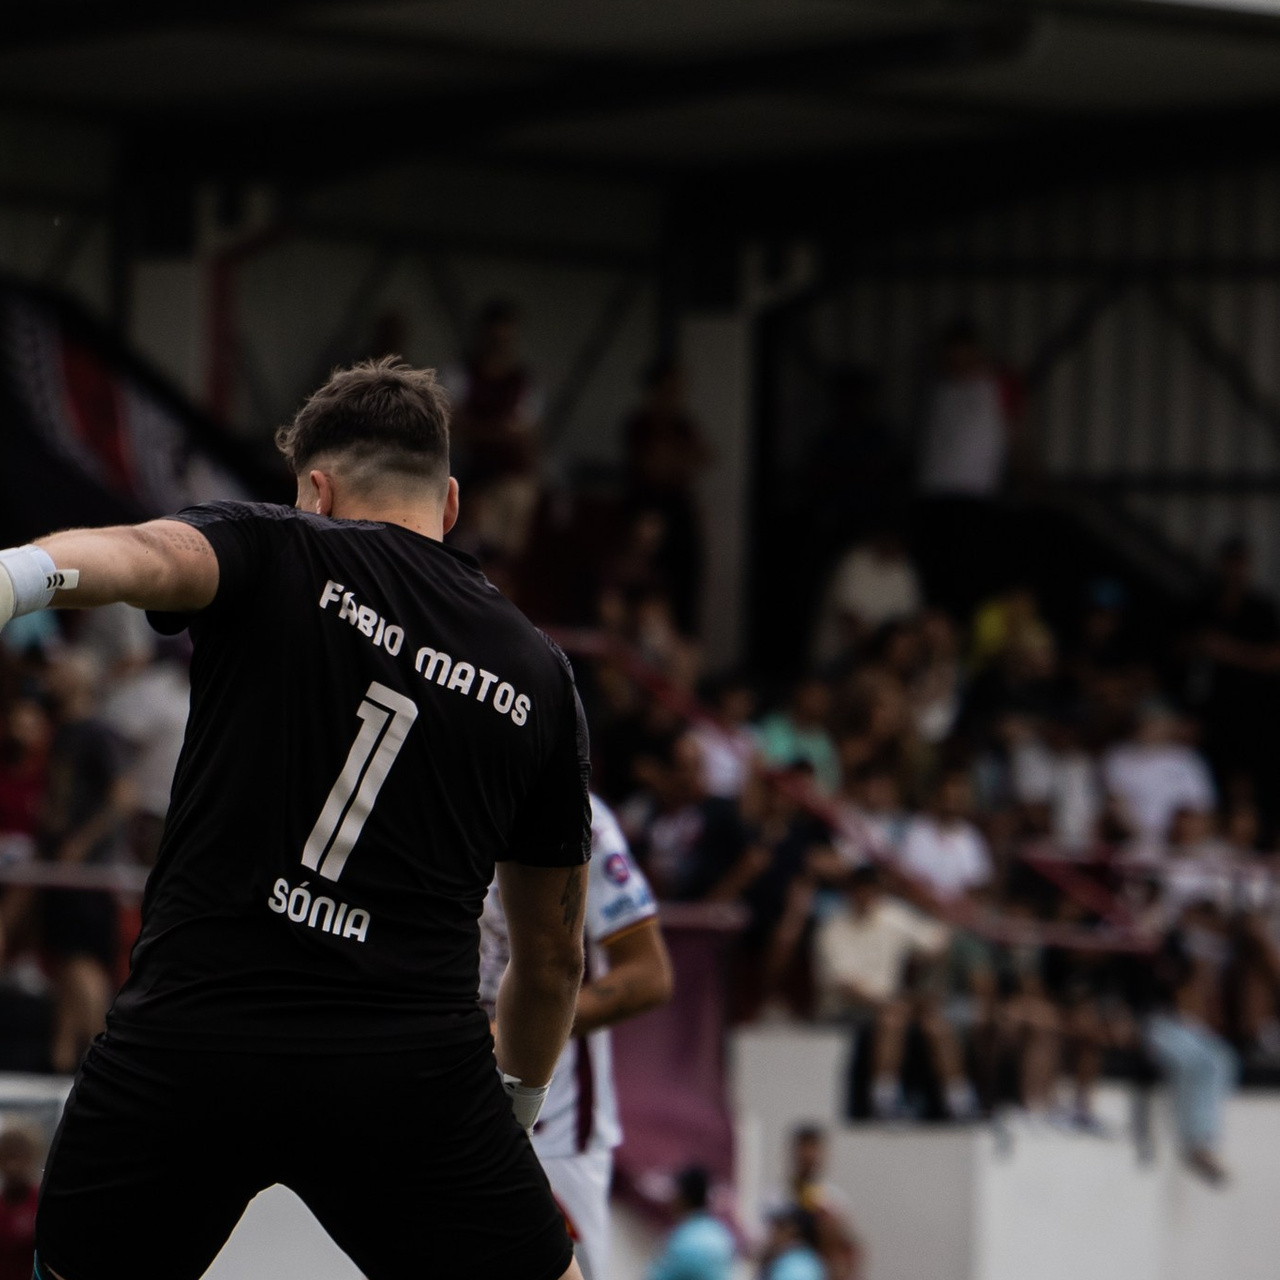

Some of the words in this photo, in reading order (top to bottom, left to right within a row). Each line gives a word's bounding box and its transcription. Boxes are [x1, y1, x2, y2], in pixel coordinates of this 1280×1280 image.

[415, 646, 532, 727] MATOS
[301, 681, 419, 883] 1
[267, 877, 371, 943] SÓNIA
